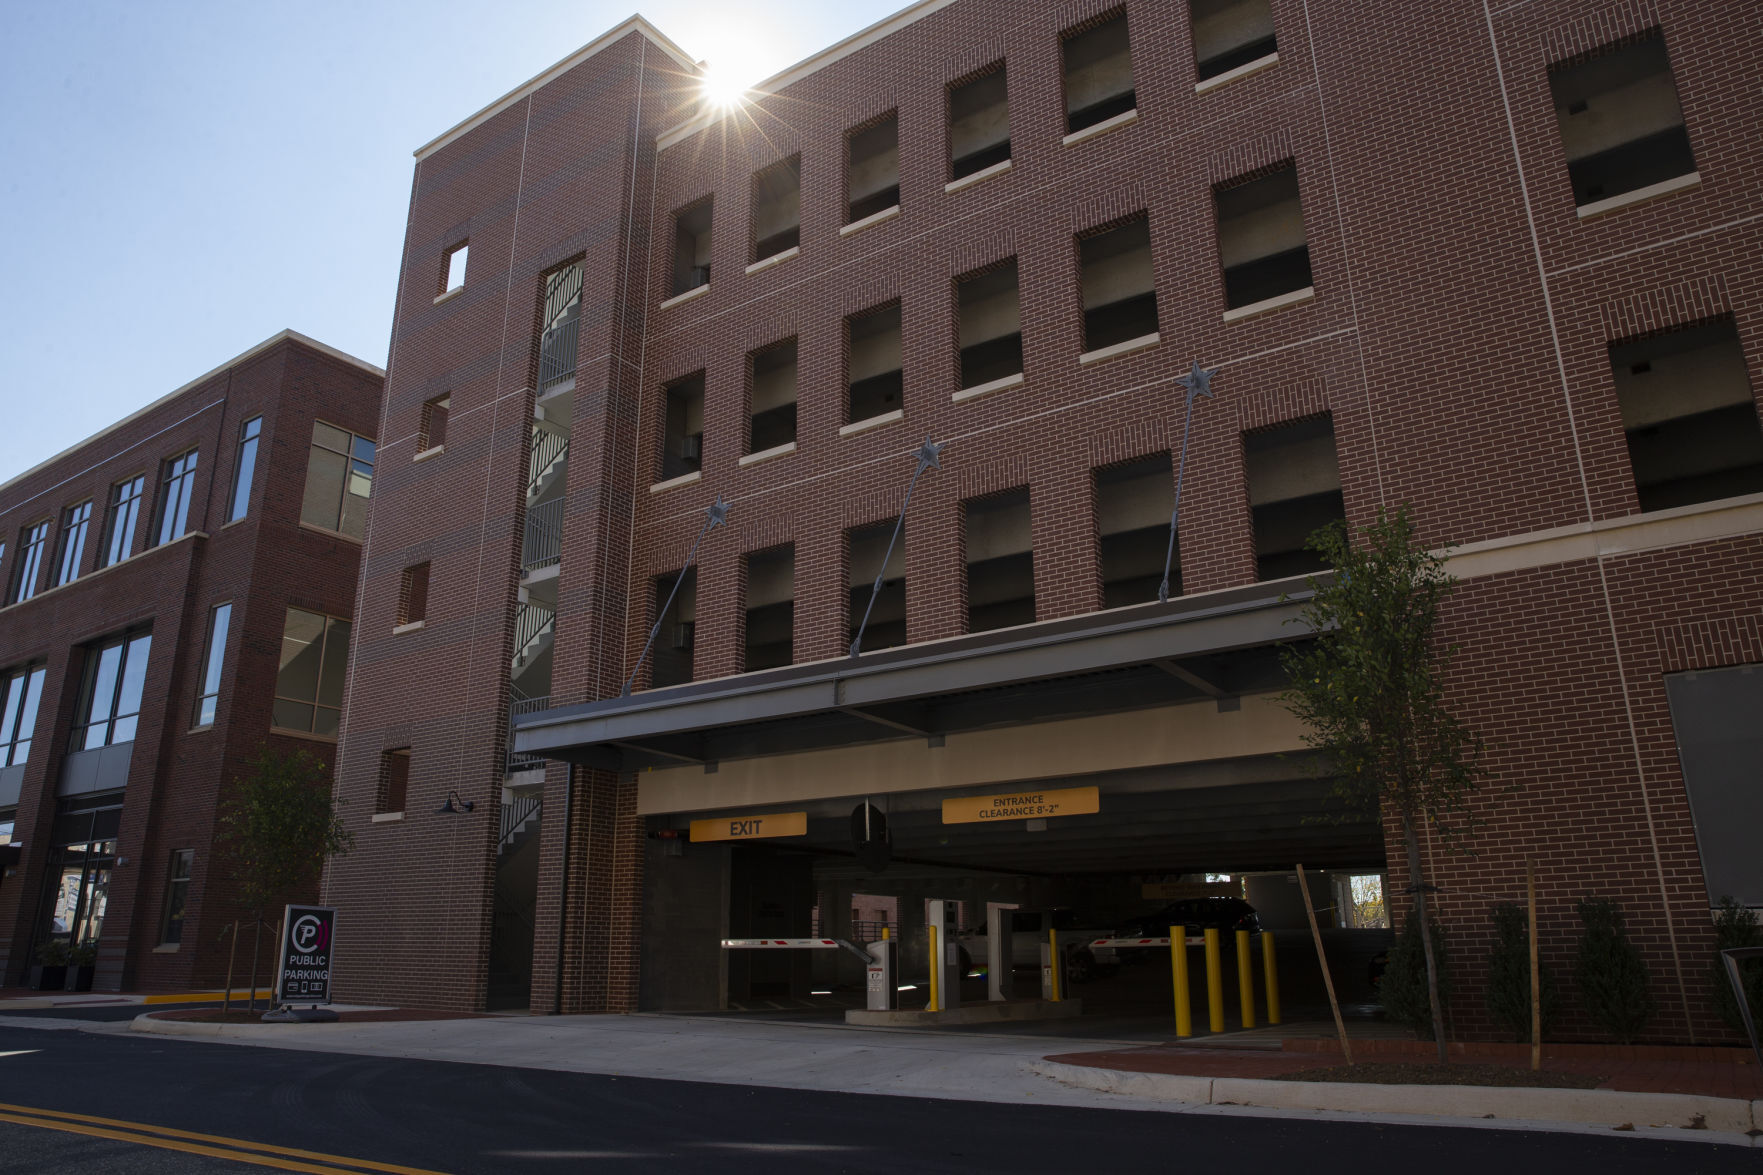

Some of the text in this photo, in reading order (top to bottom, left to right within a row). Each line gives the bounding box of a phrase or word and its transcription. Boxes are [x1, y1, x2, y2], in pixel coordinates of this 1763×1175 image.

[993, 795, 1044, 807] ENTRANCE
[979, 804, 1059, 818] CLEARANCE 8'-2"
[730, 820, 763, 836] EXIT
[289, 955, 326, 966] PUBLIC
[284, 969, 329, 980] PARKING
